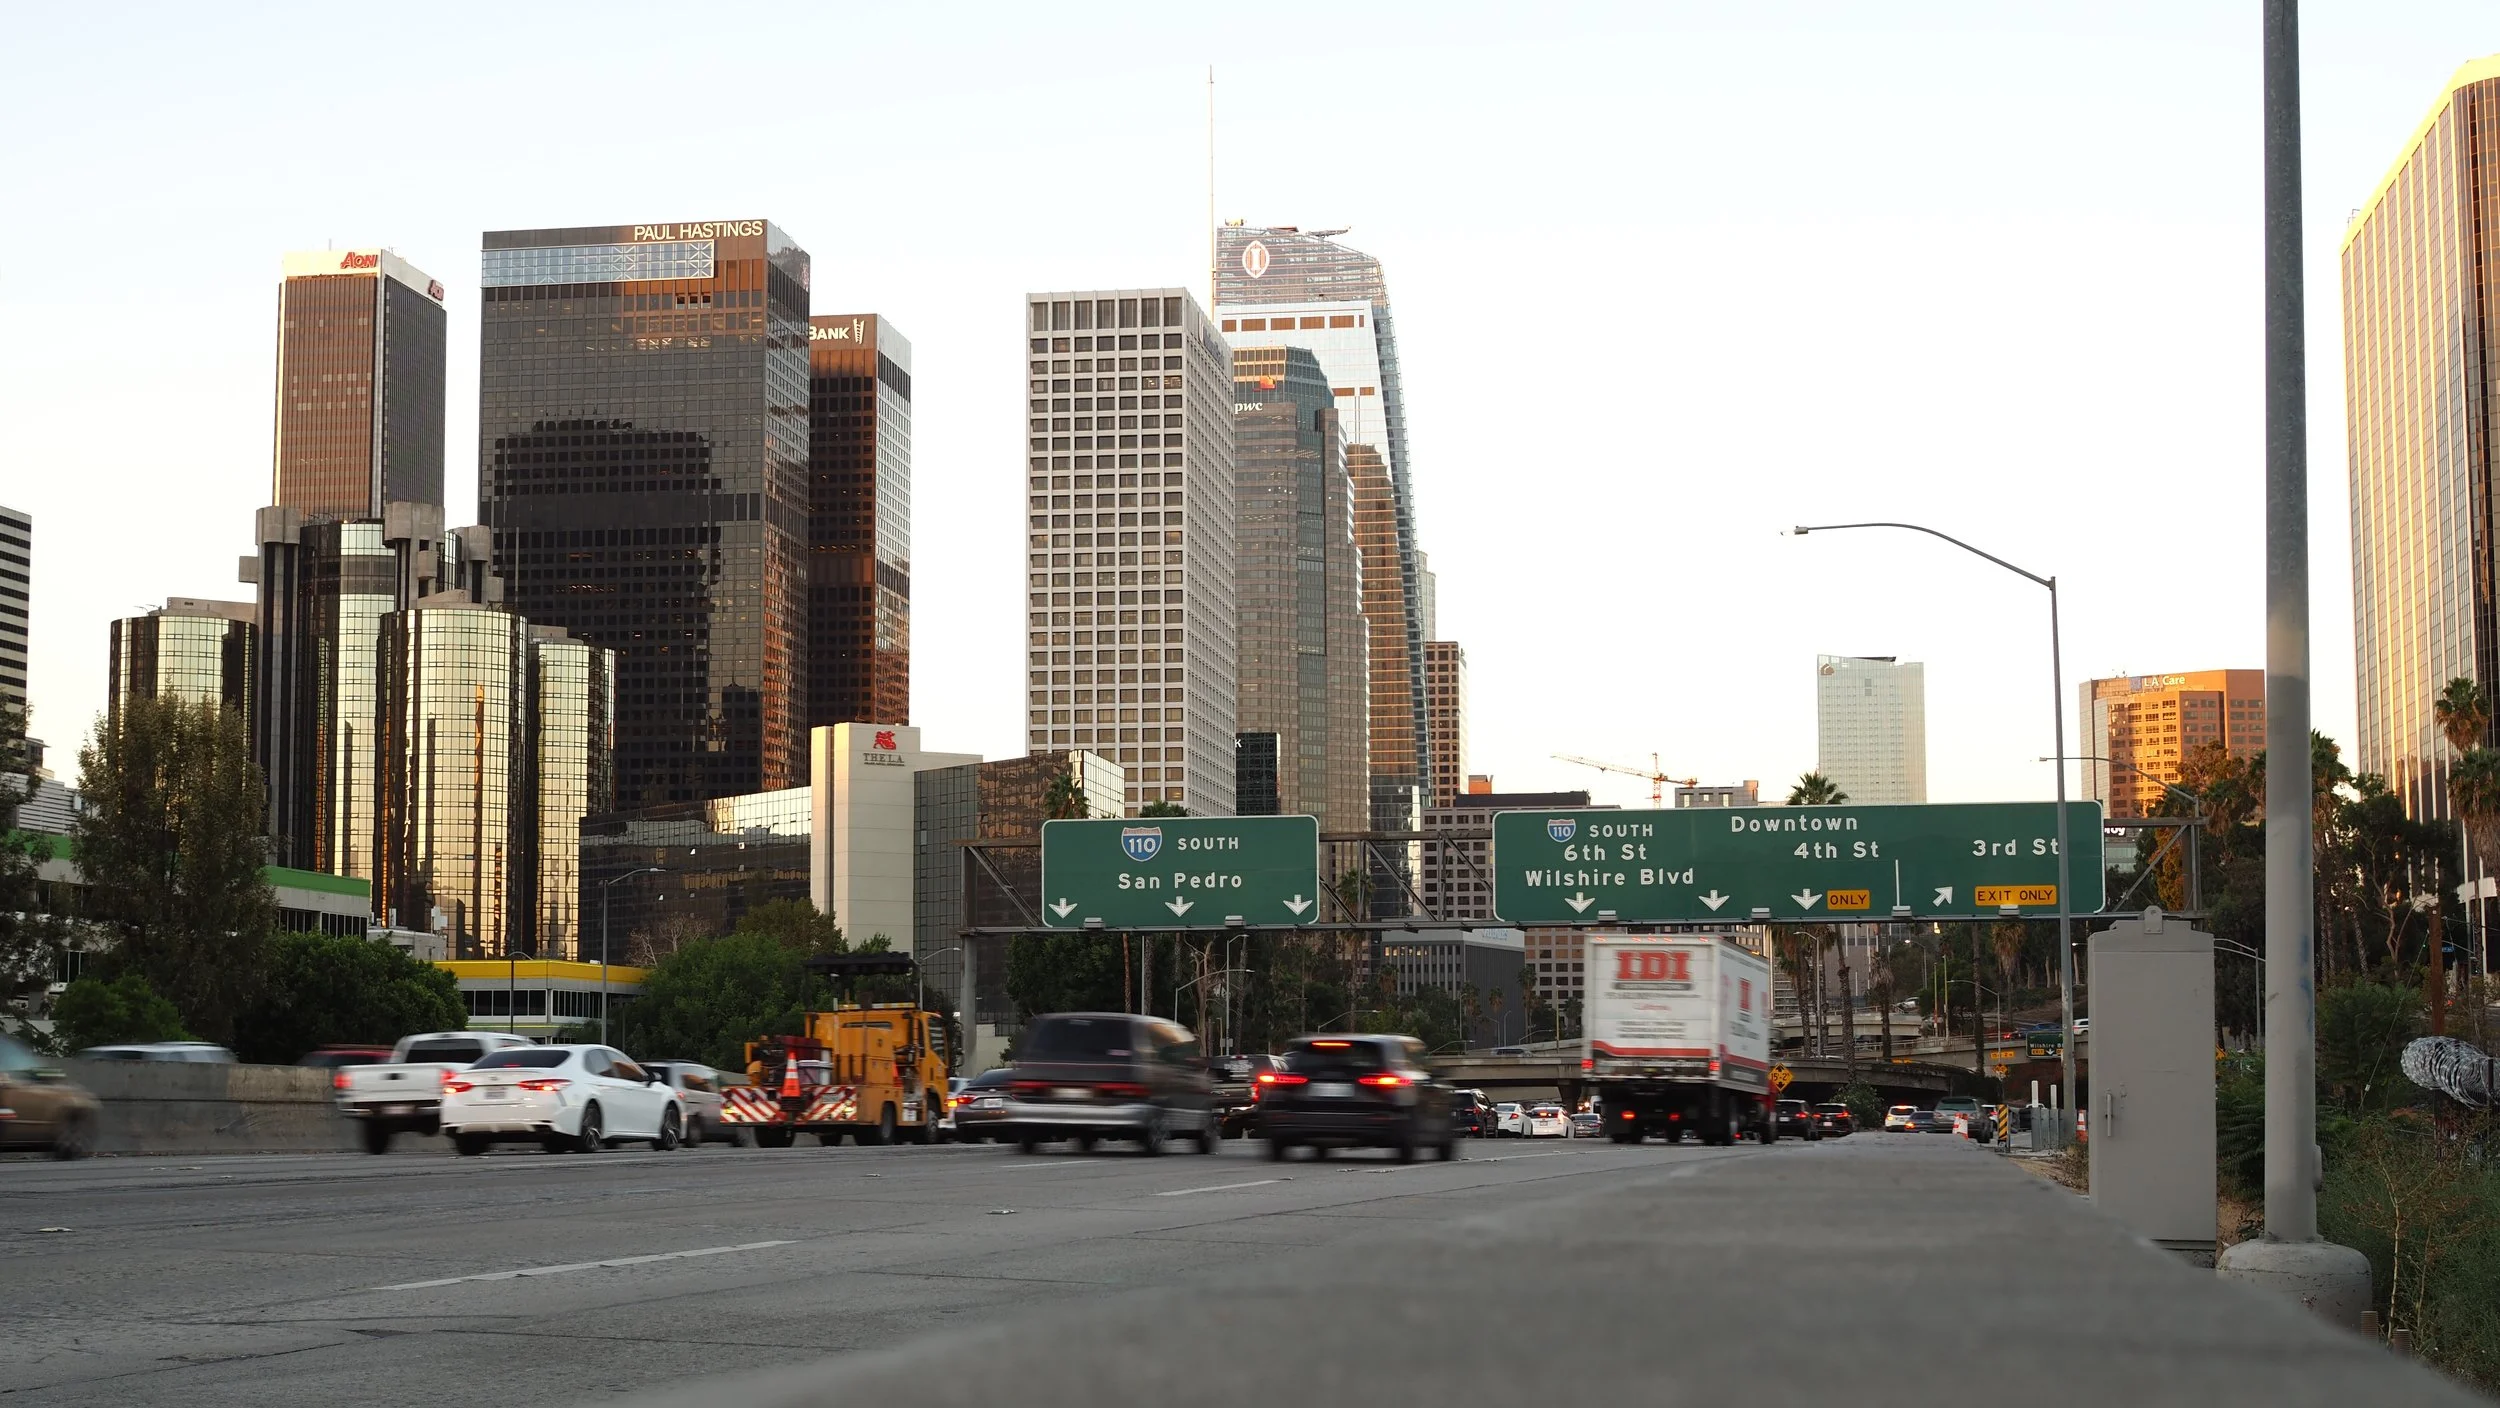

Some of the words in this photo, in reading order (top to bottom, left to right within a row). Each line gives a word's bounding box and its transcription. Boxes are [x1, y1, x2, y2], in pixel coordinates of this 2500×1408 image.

[634, 224, 675, 241] PAUL
[680, 220, 764, 240] HASTINGS
[340, 252, 378, 269] AON
[809, 325, 850, 341] BANK
[1234, 402, 1263, 415] pwc
[2162, 675, 2186, 686] Care
[863, 752, 885, 762] THE
[1553, 826, 1571, 838] 110
[1589, 824, 1653, 838] SOUTH
[1731, 814, 1858, 833] Downtown
[1128, 837, 1156, 853] 110
[1177, 837, 1239, 851] SOUTH
[1564, 844, 1606, 861] 6th
[1621, 843, 1647, 861] St
[1794, 841, 1837, 859] 4th
[1853, 841, 1879, 858] St
[1972, 838, 2017, 857] 3rd
[2032, 837, 2060, 856] St
[1118, 873, 1160, 889] San
[1174, 871, 1242, 889] Pedro
[1525, 868, 1626, 887] Wilshire
[1640, 867, 1694, 885] Blvd
[1830, 894, 1867, 905] ONLY
[1977, 890, 2012, 901] EXIT
[2019, 889, 2053, 901] ONLY
[1615, 951, 1691, 981] IDI
